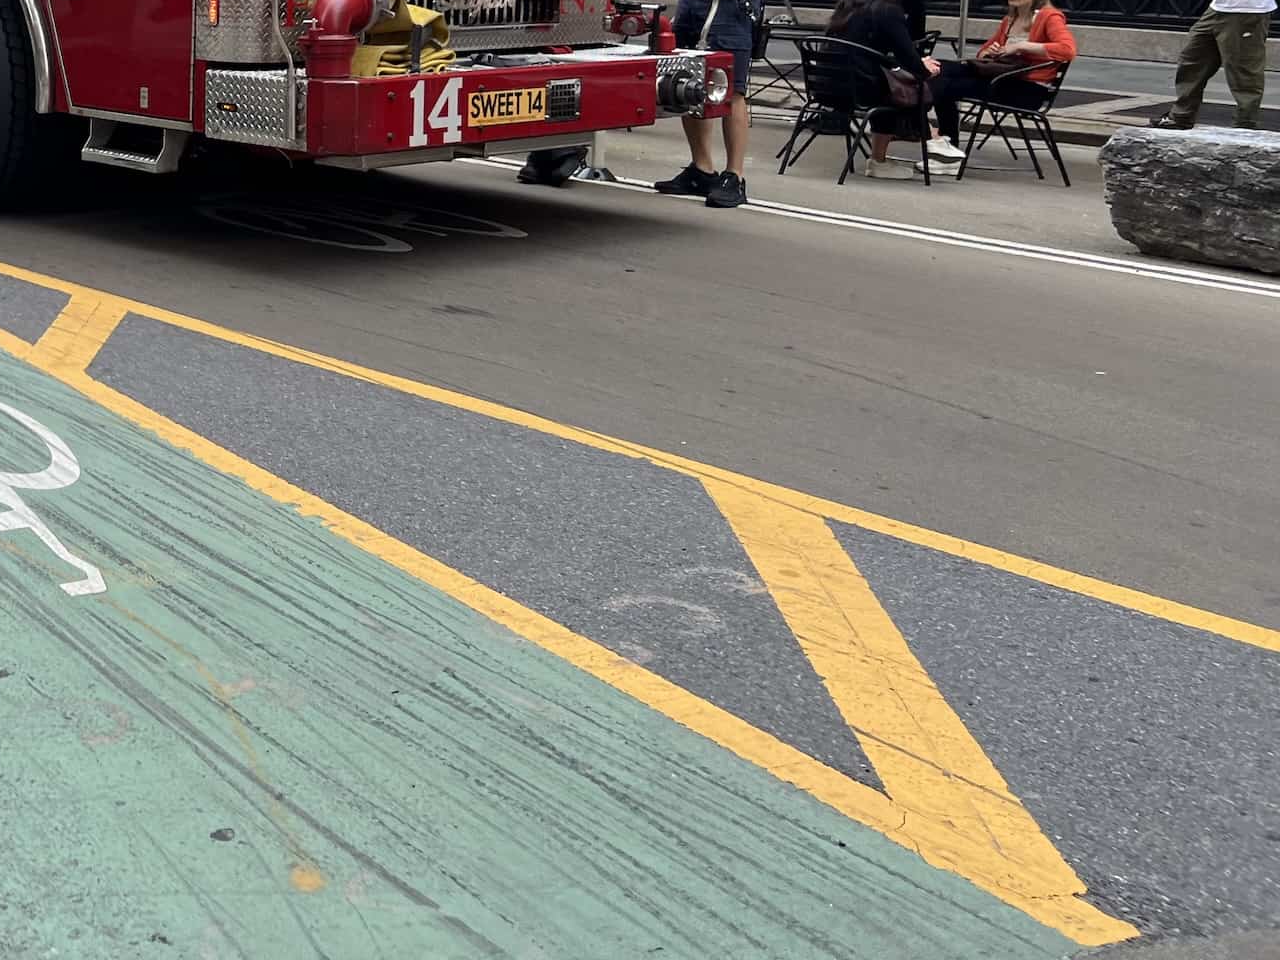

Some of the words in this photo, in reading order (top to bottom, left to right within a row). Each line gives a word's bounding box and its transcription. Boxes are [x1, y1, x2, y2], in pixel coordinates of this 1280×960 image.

[409, 77, 464, 147] 14
[471, 93, 523, 119] SWEET
[527, 91, 543, 114] 14
